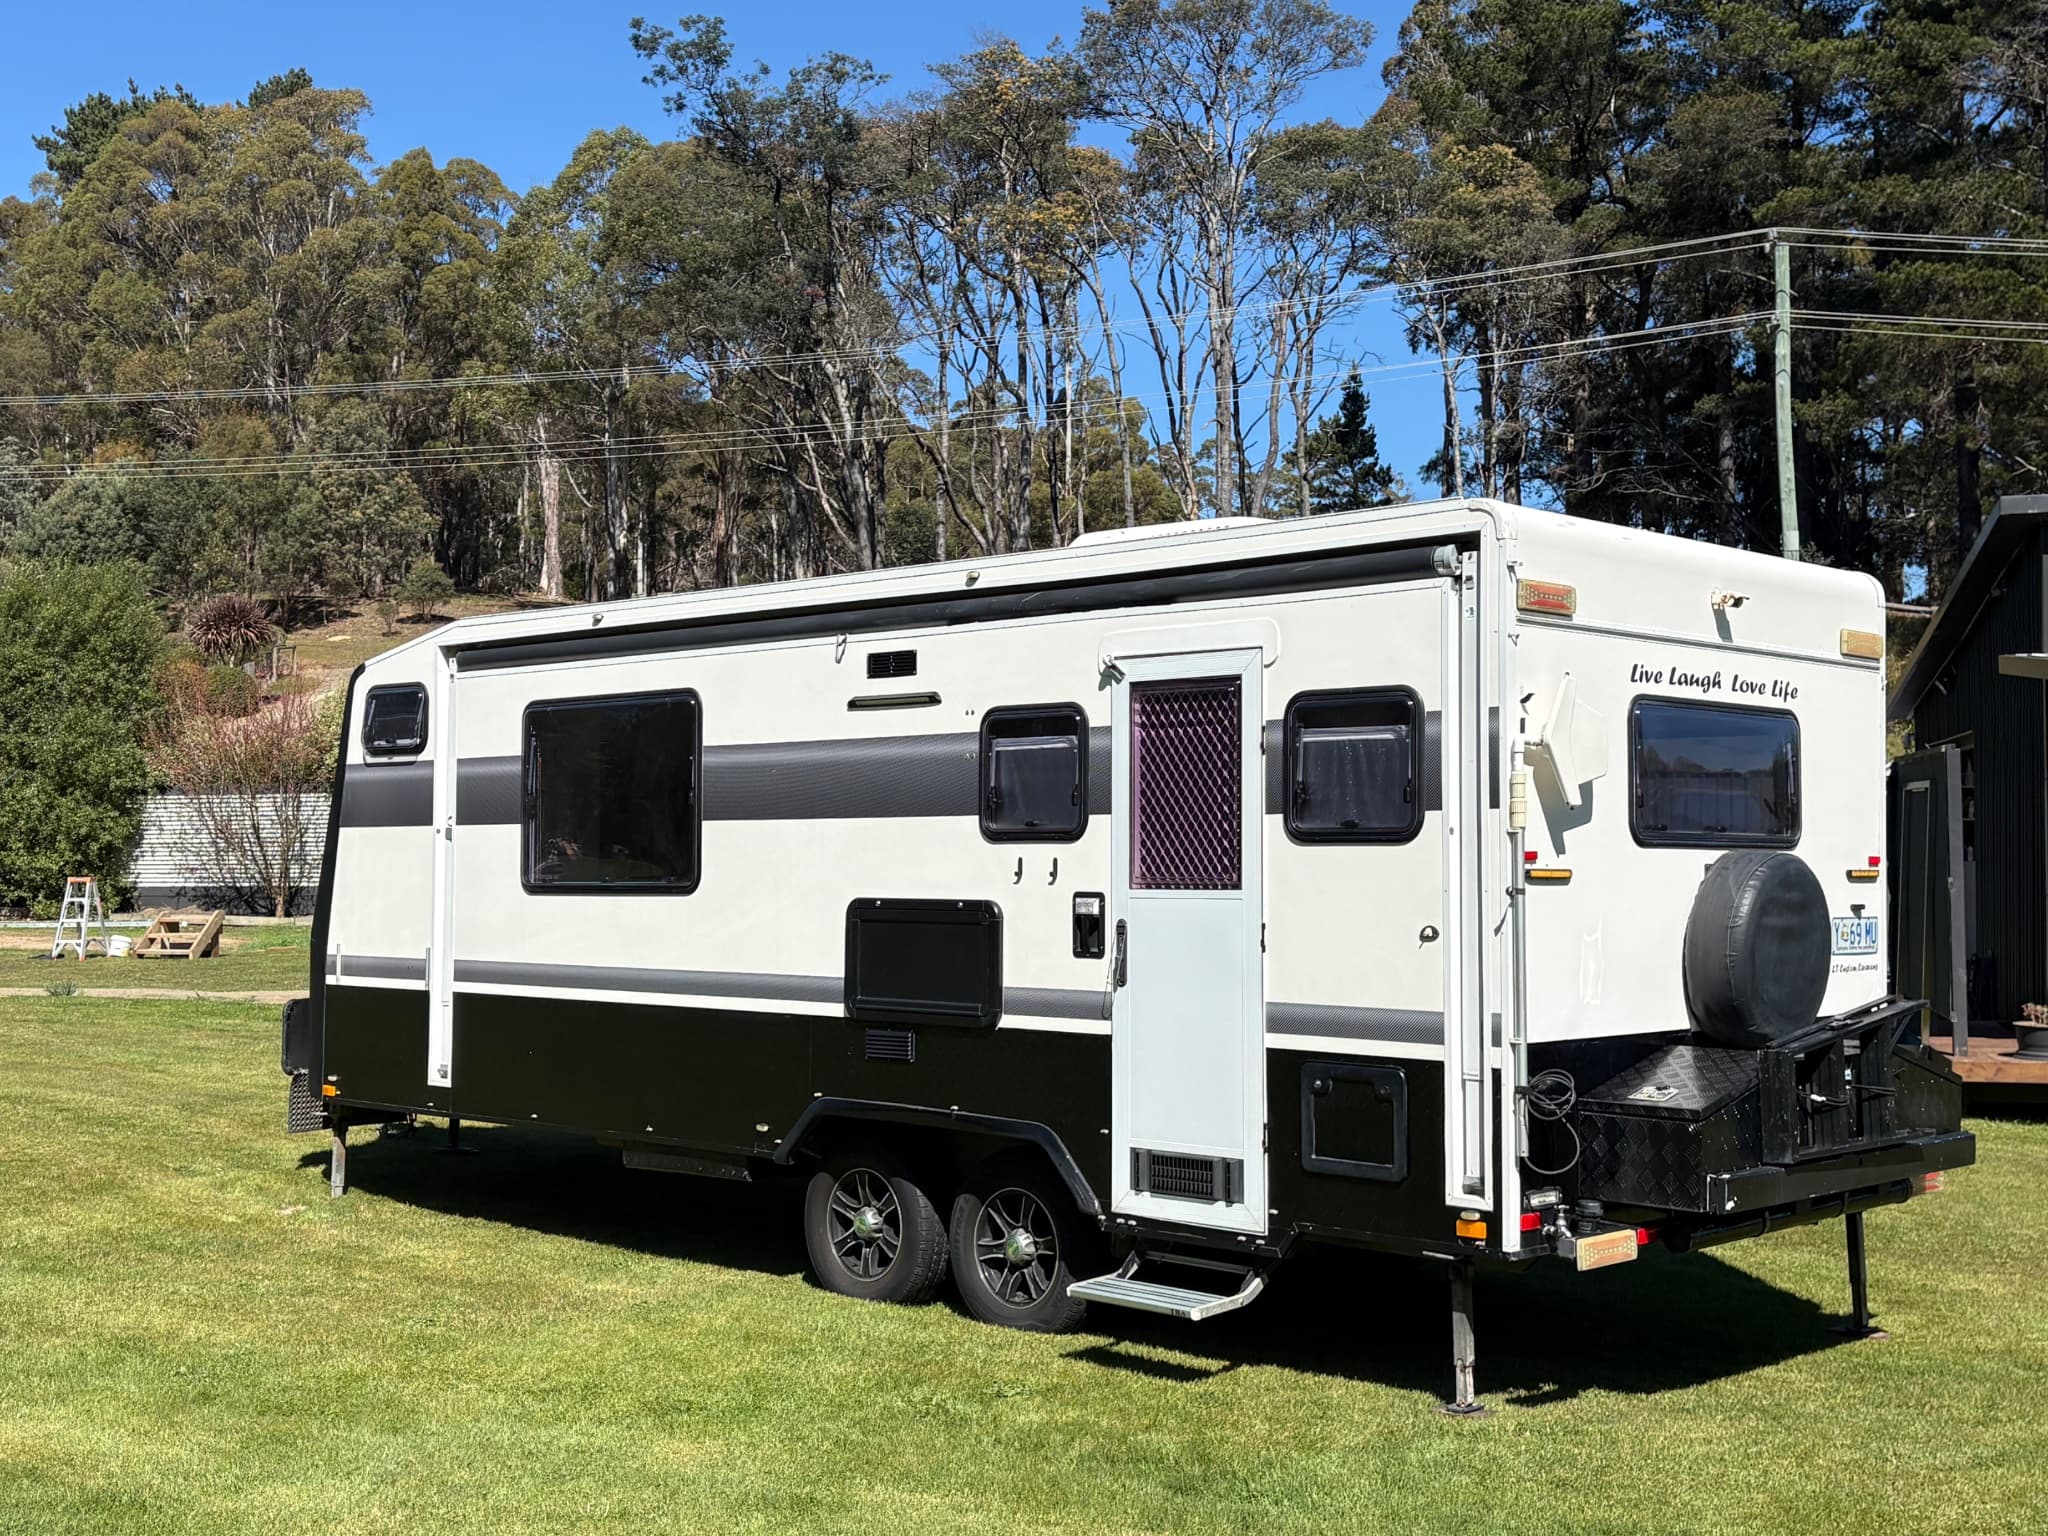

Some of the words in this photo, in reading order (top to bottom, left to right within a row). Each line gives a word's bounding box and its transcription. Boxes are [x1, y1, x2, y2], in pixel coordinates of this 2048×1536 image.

[1630, 664, 1663, 684] Live
[1669, 667, 1721, 693] Laugh
[1732, 674, 1766, 695] Love
[1771, 680, 1798, 703] Life
